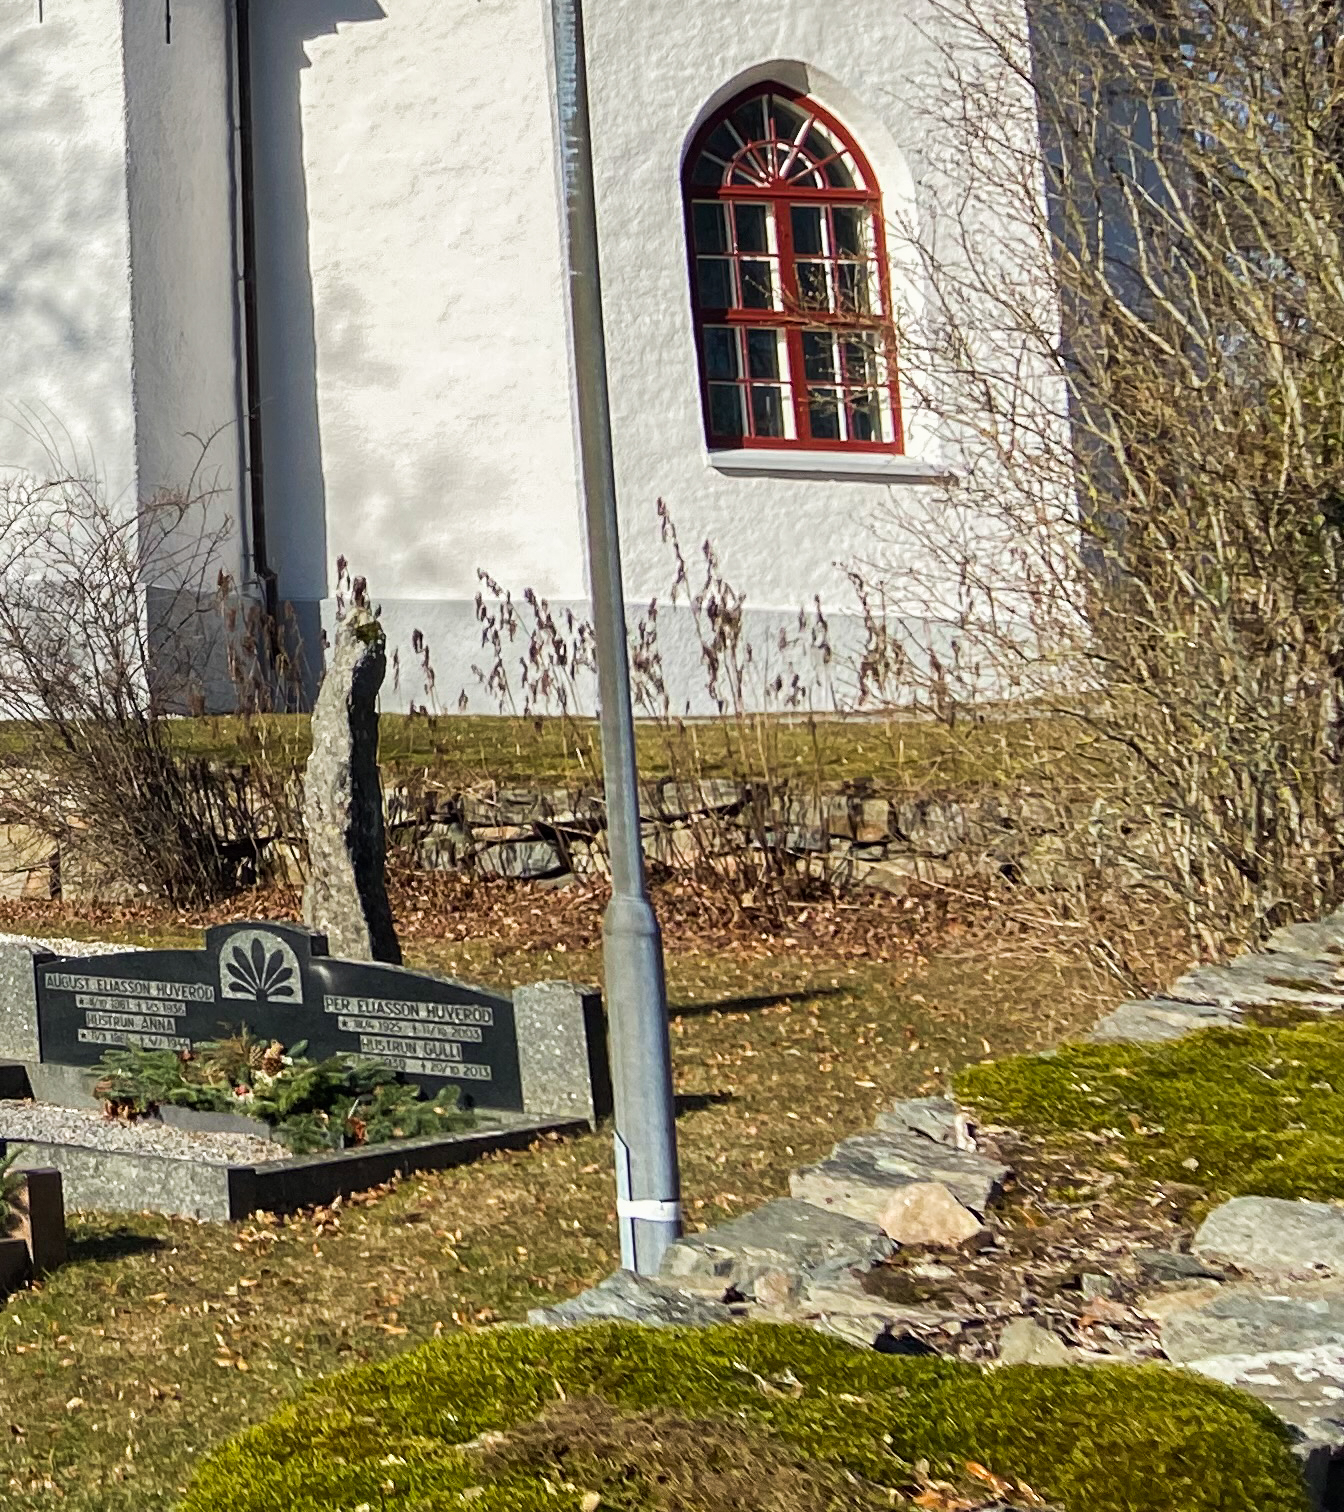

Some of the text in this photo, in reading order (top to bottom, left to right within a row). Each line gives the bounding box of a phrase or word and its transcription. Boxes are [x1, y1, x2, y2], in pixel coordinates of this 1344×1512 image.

[46, 973, 213, 1001] AUGUST ELIASSON HUVERÖD
[324, 996, 492, 1023] PER ELIASSON HUVERÖD
[86, 1011, 175, 1033] HUSTRUN ANNA
[361, 1036, 461, 1059] HUSTRUN GULLI
[463, 1064, 490, 1079] 2013
